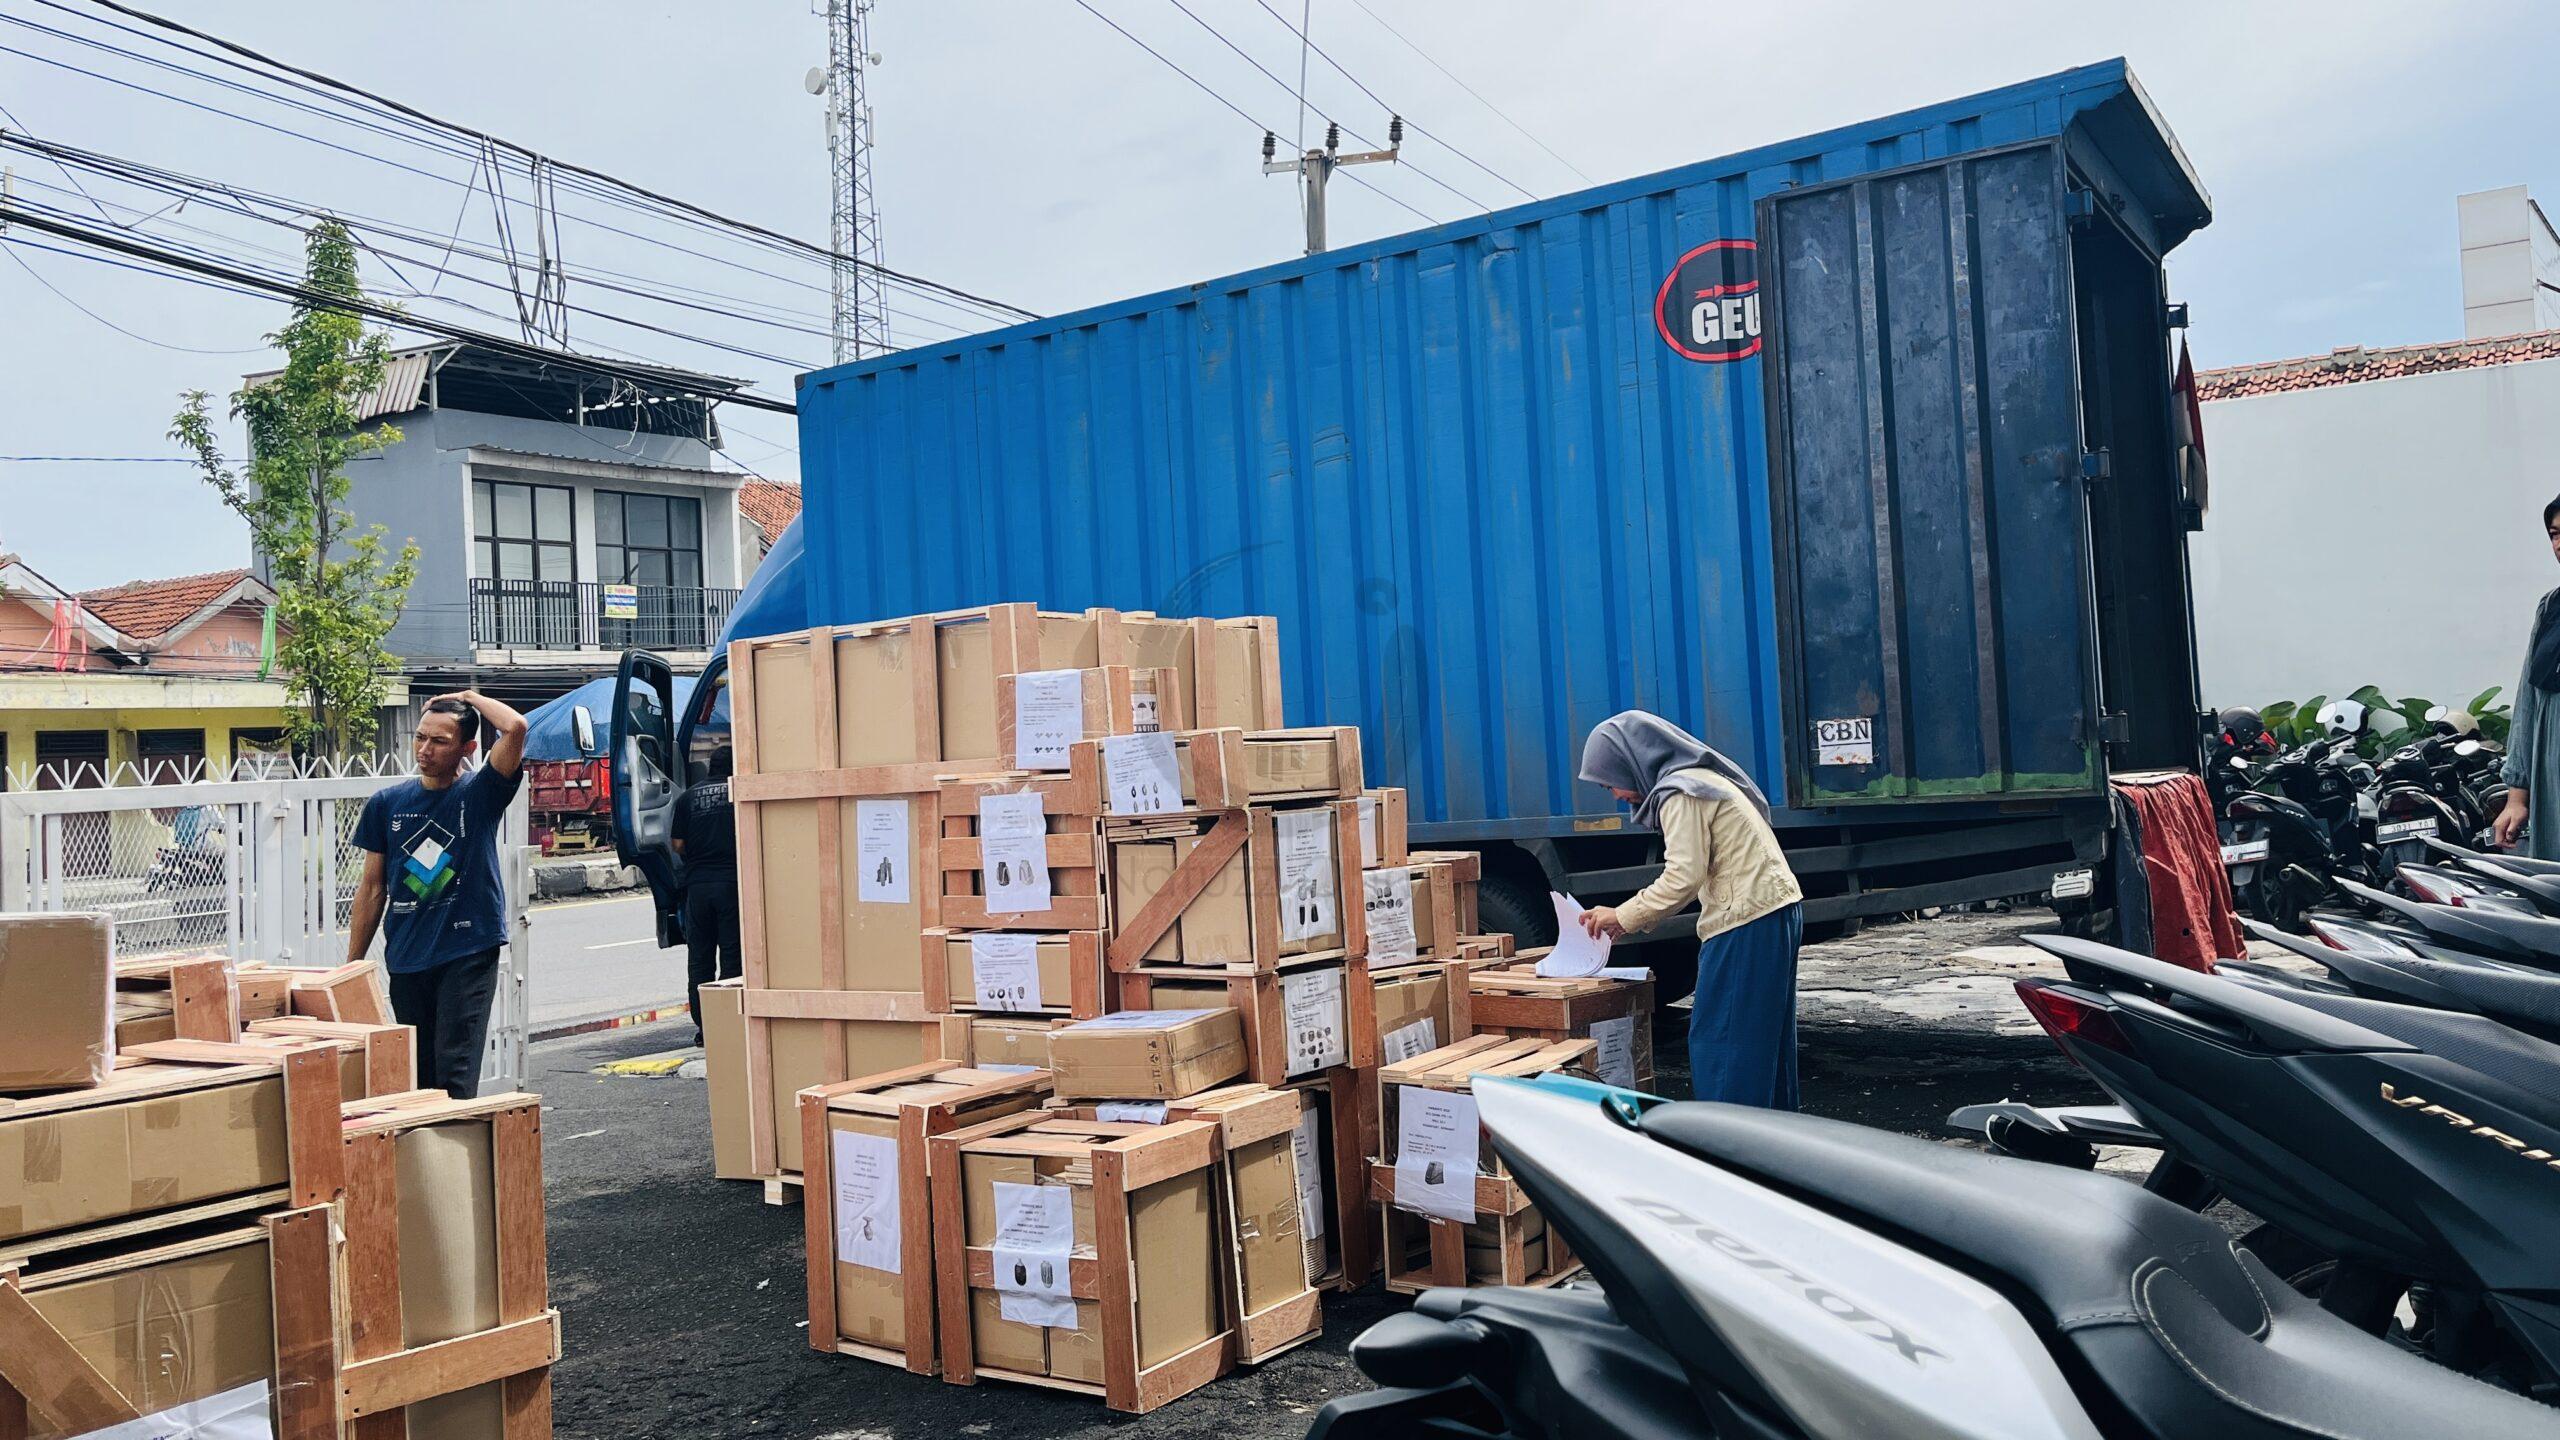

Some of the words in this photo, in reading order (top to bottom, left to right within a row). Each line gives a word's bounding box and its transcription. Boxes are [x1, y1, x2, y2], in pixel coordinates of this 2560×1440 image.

[1820, 720, 1869, 741] CBN
[2381, 1082, 2560, 1173] VARI
[1615, 1197, 1949, 1365] aerox
